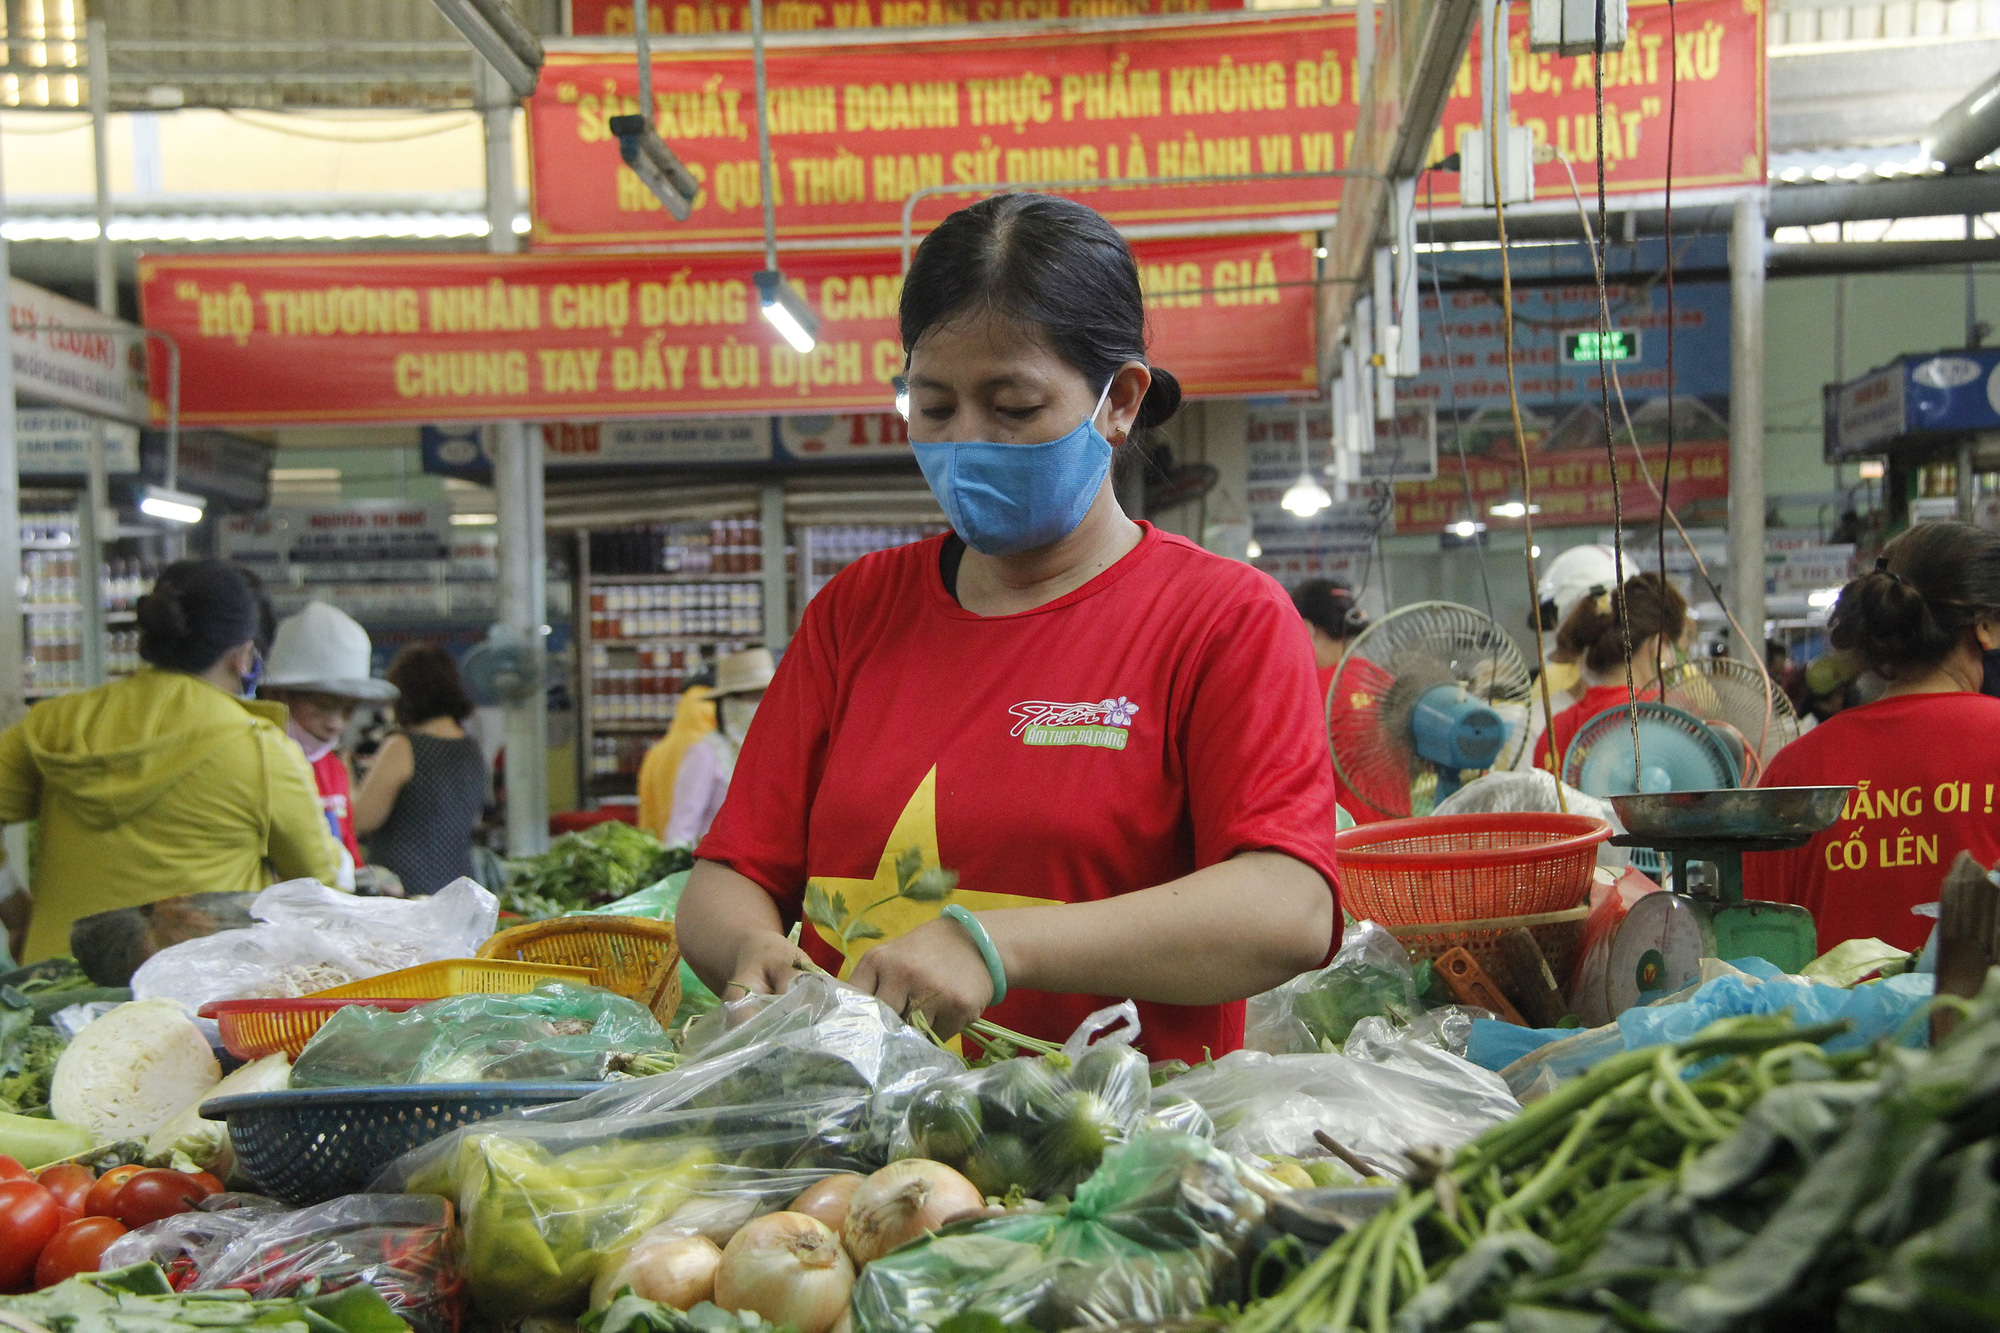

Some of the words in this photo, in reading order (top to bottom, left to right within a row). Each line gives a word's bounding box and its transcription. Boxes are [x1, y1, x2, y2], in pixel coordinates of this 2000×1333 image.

[844, 82, 959, 132] DOANH
[966, 71, 1053, 135] THỰC
[1061, 53, 1162, 121] PHẨM
[1169, 54, 1287, 116] KHÔNG
[1295, 50, 1342, 108] RÕ
[1674, 20, 1725, 82] XỨ
[789, 145, 865, 206] THỜI
[1258, 133, 1293, 182] VI
[263, 286, 420, 336] THƯƠNG
[428, 278, 541, 332] NHÂN
[550, 280, 631, 337] CHỢ
[639, 267, 746, 327] ĐỐNG
[1213, 250, 1280, 306] GIÁ
[395, 352, 529, 396] CHUNG
[538, 350, 601, 393] TAY
[610, 331, 689, 390] ĐẨY
[699, 334, 761, 390] LÙI
[1825, 826, 1868, 871] CỐ
[1879, 827, 1938, 868] LÊN
